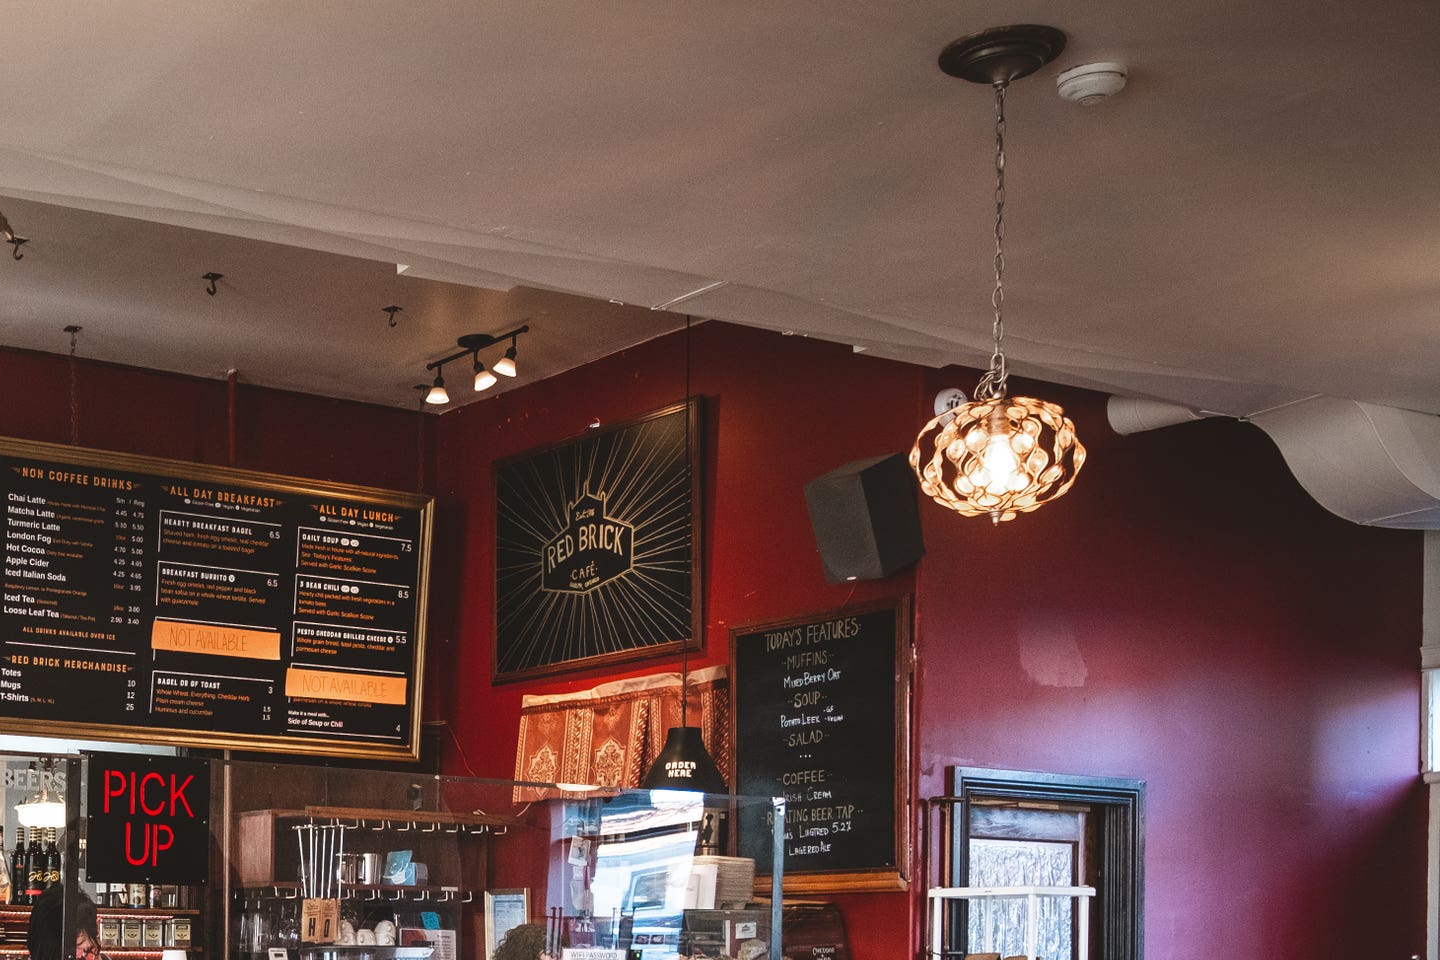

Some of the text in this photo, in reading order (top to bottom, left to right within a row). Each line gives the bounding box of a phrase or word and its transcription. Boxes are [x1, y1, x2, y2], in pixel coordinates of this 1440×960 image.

[22, 467, 132, 490] NON COFFEE DRINKS
[8, 493, 46, 504] Chai Latte
[170, 486, 275, 508] ALL DAY BREAKFAST
[8, 506, 55, 518] Matcha Latte
[320, 504, 393, 522] ALL DAY LUNCH
[8, 518, 60, 531] Turmeric Latte
[164, 518, 252, 535] HEARTY BREAKFAST BAGEL
[7, 531, 51, 544] London Fog
[323, 536, 338, 544] SOUP
[22, 545, 45, 554] Cocoa
[548, 523, 623, 574] RED BRICK
[5, 568, 66, 581] Iced Italian Soda
[162, 568, 227, 581] BREAKFAST BURRITO
[4, 606, 59, 618] Loose Leaf Tea
[170, 627, 248, 652] NOT AVAILABLE
[764, 617, 859, 652] TODAY'S FEATURES
[12, 655, 127, 672] RED BRICK MERCHANDISE
[1, 668, 21, 676] Totes
[804, 671, 825, 685] BERRY
[1, 680, 21, 690] Mugs
[0, 692, 29, 702] T-Shirts
[331, 720, 343, 728] Chili
[1, 767, 66, 792] BEERS
[668, 769, 692, 777] HERE
[783, 770, 825, 785] COFFEE
[104, 770, 195, 818] PICK
[812, 805, 855, 821] BEER TAP
[125, 822, 174, 867] UP
